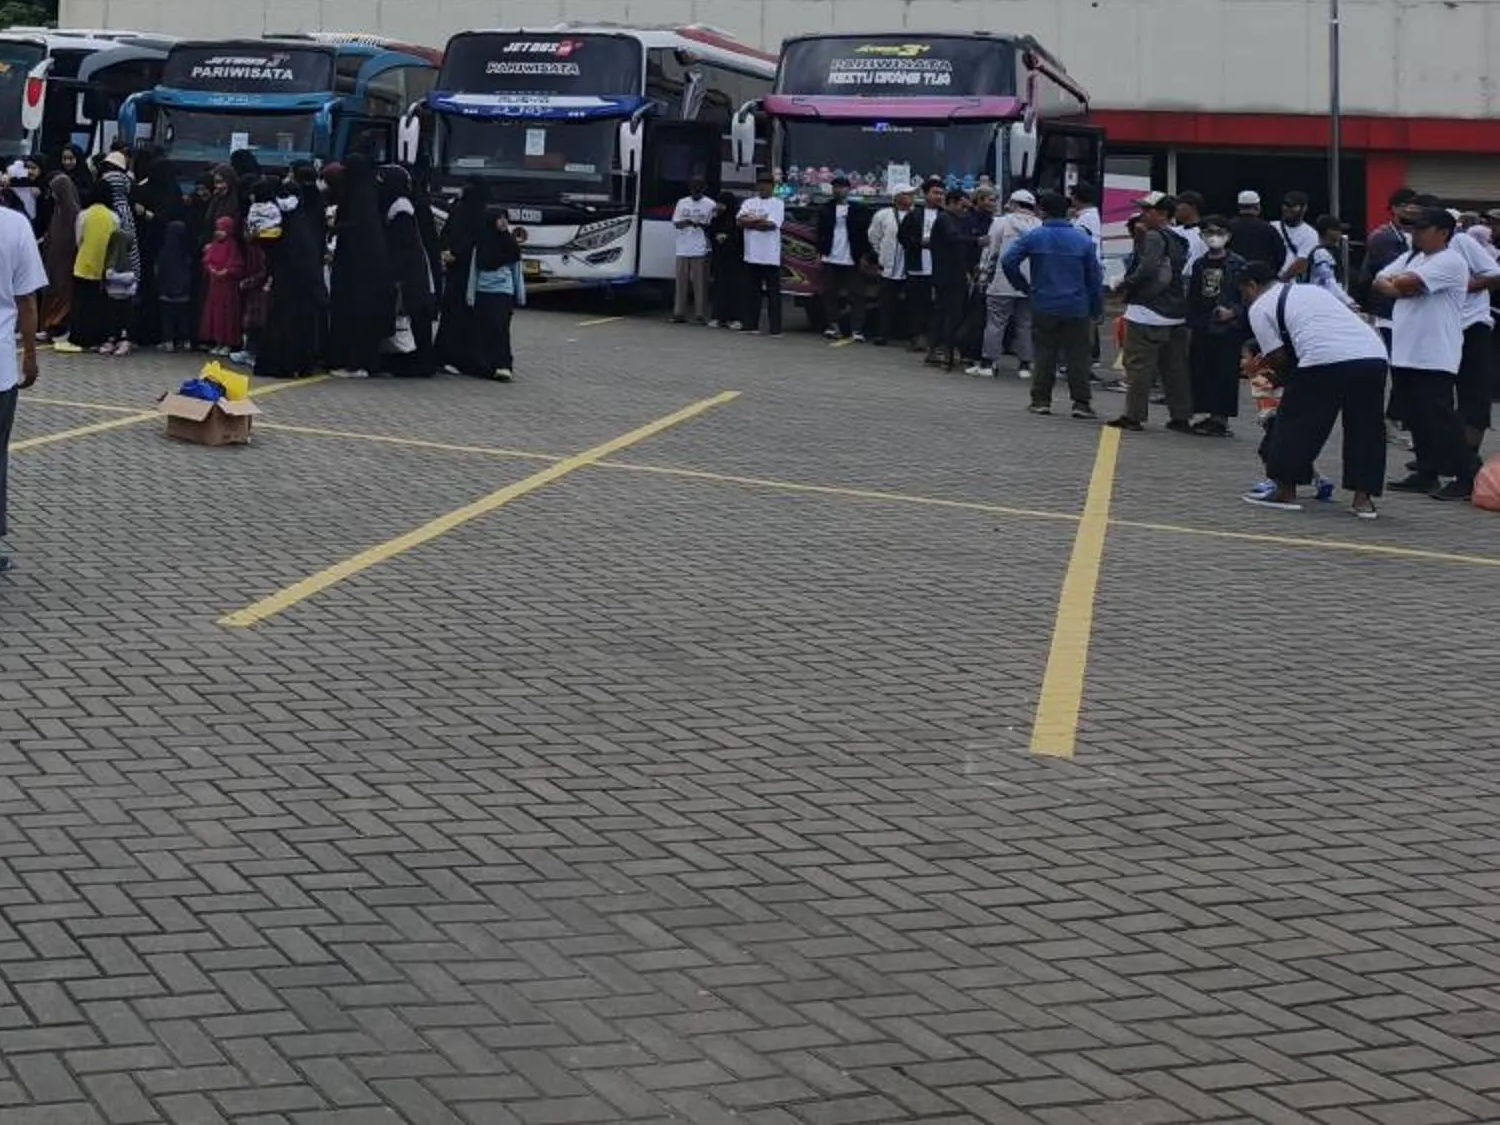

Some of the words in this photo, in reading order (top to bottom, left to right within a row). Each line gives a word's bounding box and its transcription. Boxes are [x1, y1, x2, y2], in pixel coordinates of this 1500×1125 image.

[190, 66, 293, 80] PARIWISATA
[485, 61, 580, 75] PARIWISATA
[923, 72, 951, 86] TUA
